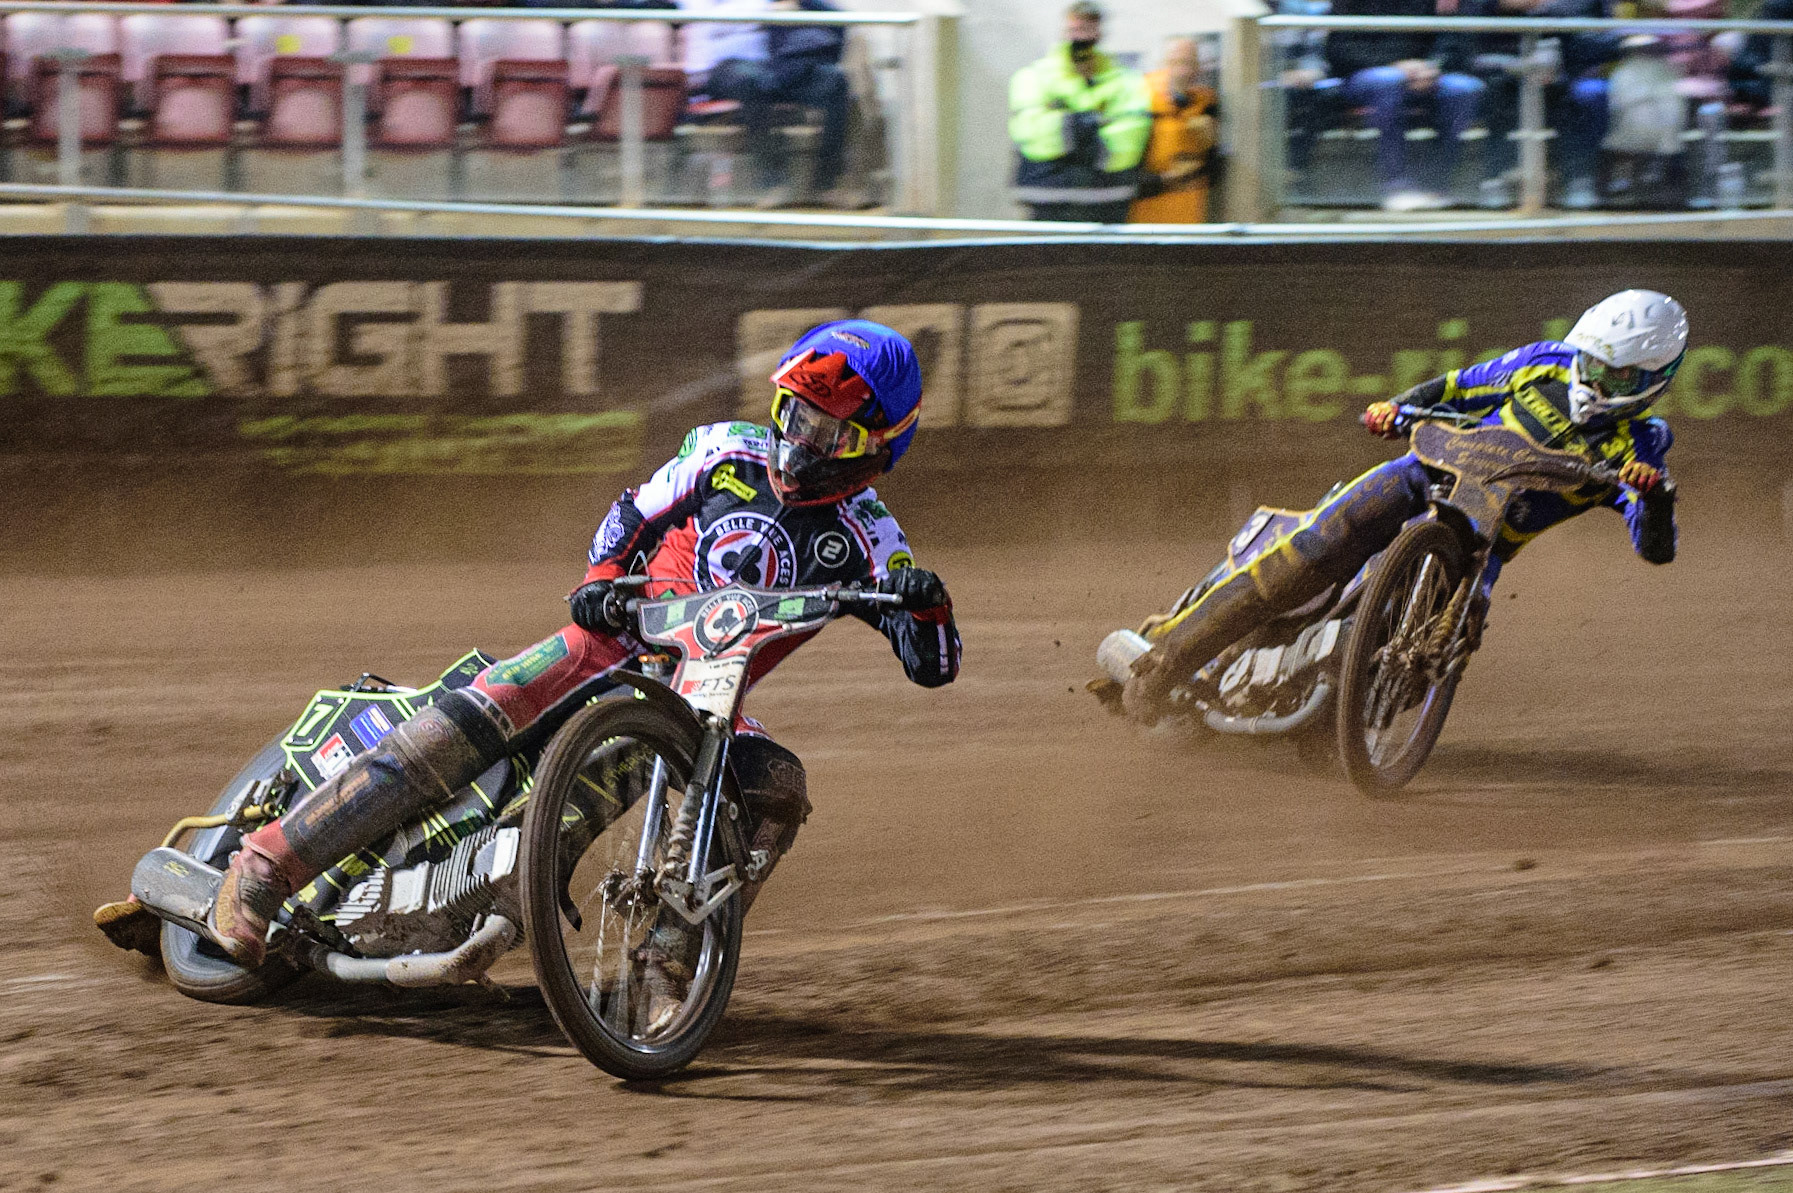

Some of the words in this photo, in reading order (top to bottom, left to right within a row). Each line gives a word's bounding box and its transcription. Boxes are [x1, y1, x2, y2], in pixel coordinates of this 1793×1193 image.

[715, 518, 755, 537] BELLE
[779, 550, 791, 585] ACES
[700, 675, 736, 692] FTS
